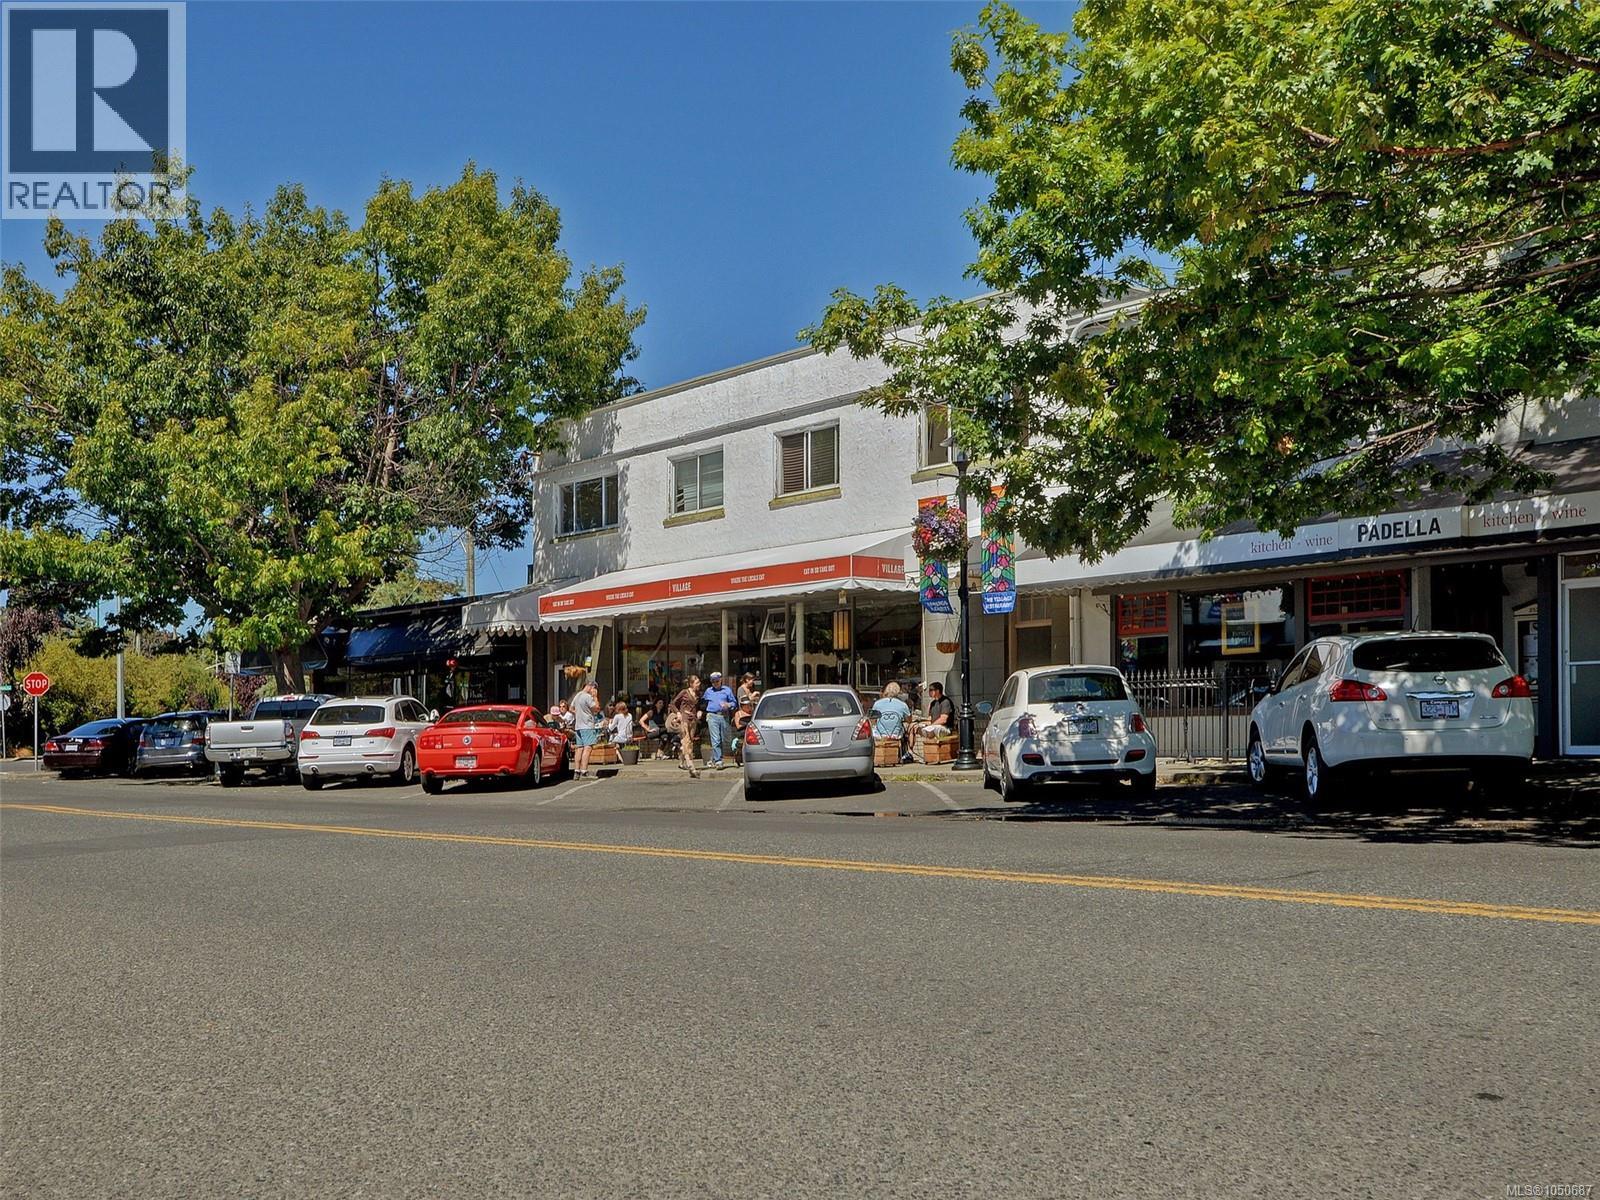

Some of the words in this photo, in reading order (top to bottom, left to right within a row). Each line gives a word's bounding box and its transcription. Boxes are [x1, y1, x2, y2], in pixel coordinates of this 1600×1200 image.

[1483, 512, 1534, 528] kitchen
[1552, 504, 1586, 520] wine
[1358, 517, 1441, 542] PADELLA
[1251, 540, 1292, 553] kitchen
[1305, 534, 1333, 547] wine
[672, 581, 691, 593] VILLAGE
[26, 681, 48, 689] STOP
